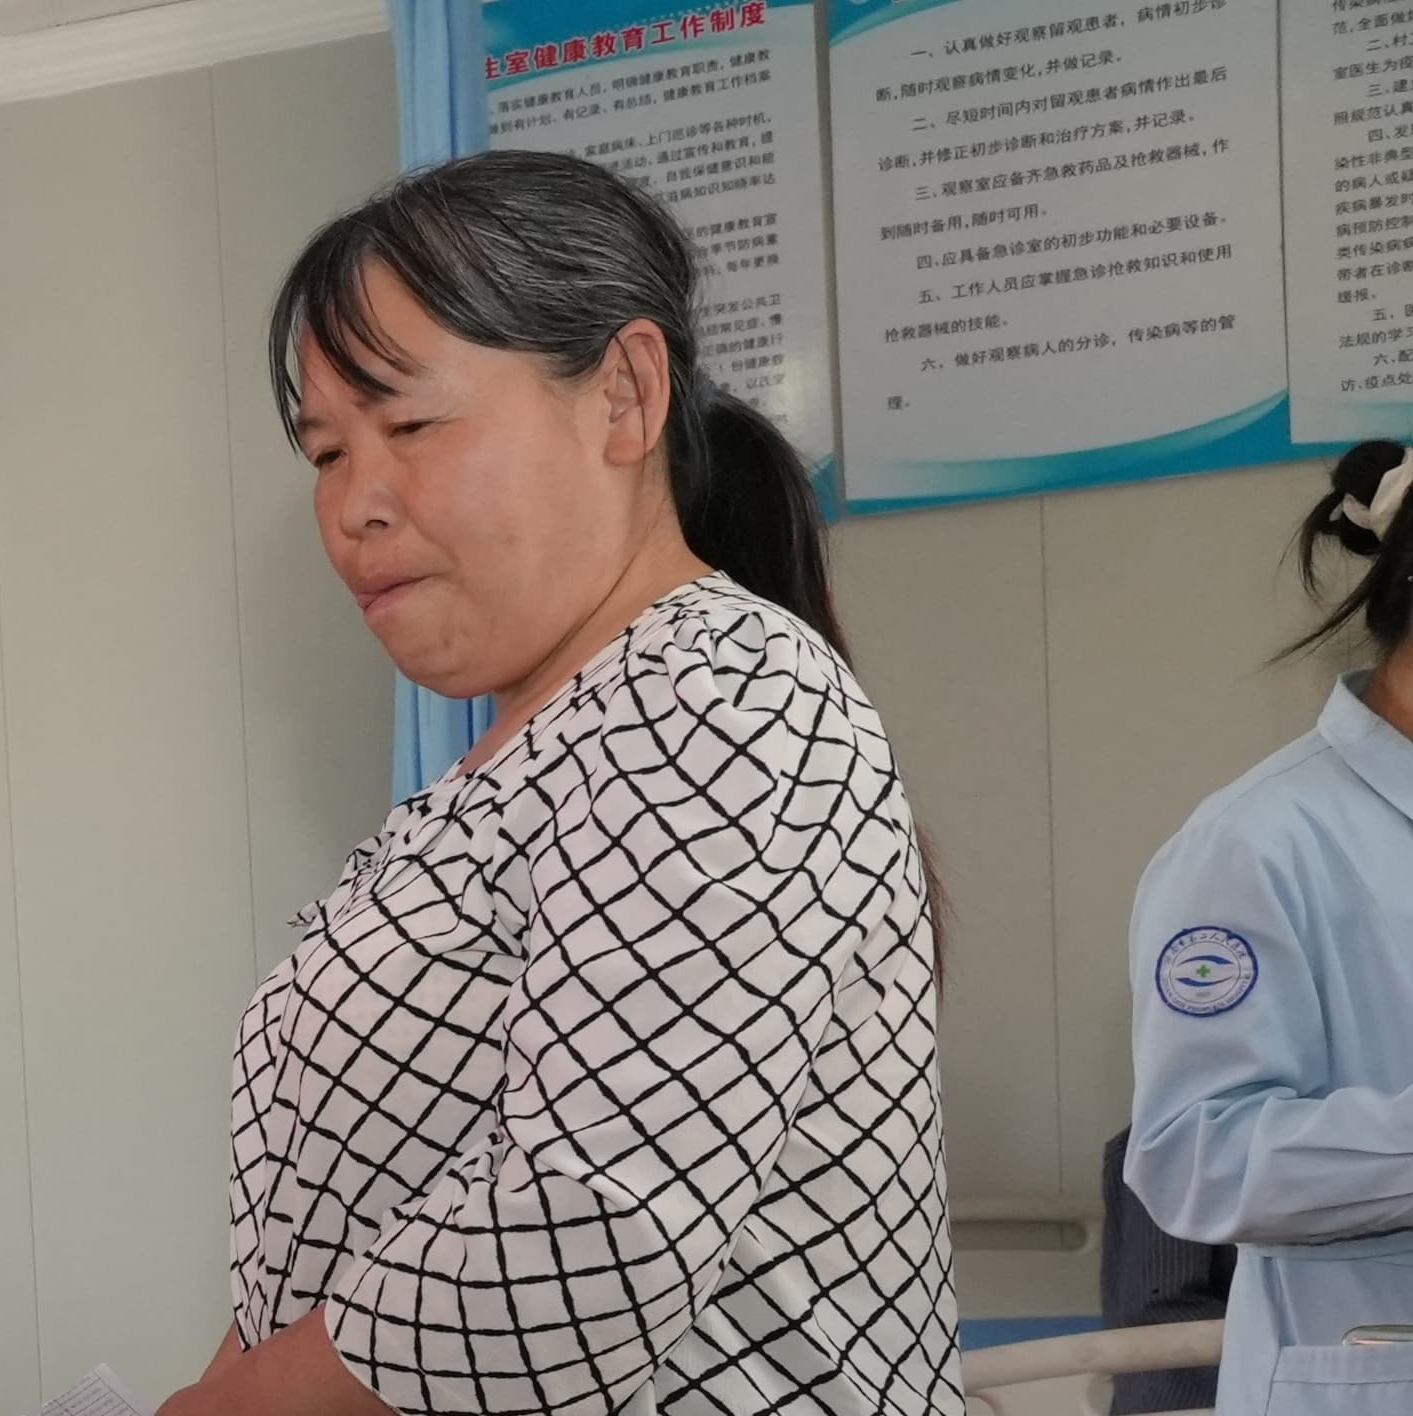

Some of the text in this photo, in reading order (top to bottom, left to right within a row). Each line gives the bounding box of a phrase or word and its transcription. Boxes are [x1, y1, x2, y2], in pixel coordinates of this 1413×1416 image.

[1366, 32, 1413, 51] 二、村
[1368, 79, 1413, 97] 三、建
[1368, 124, 1413, 143] 四、发
